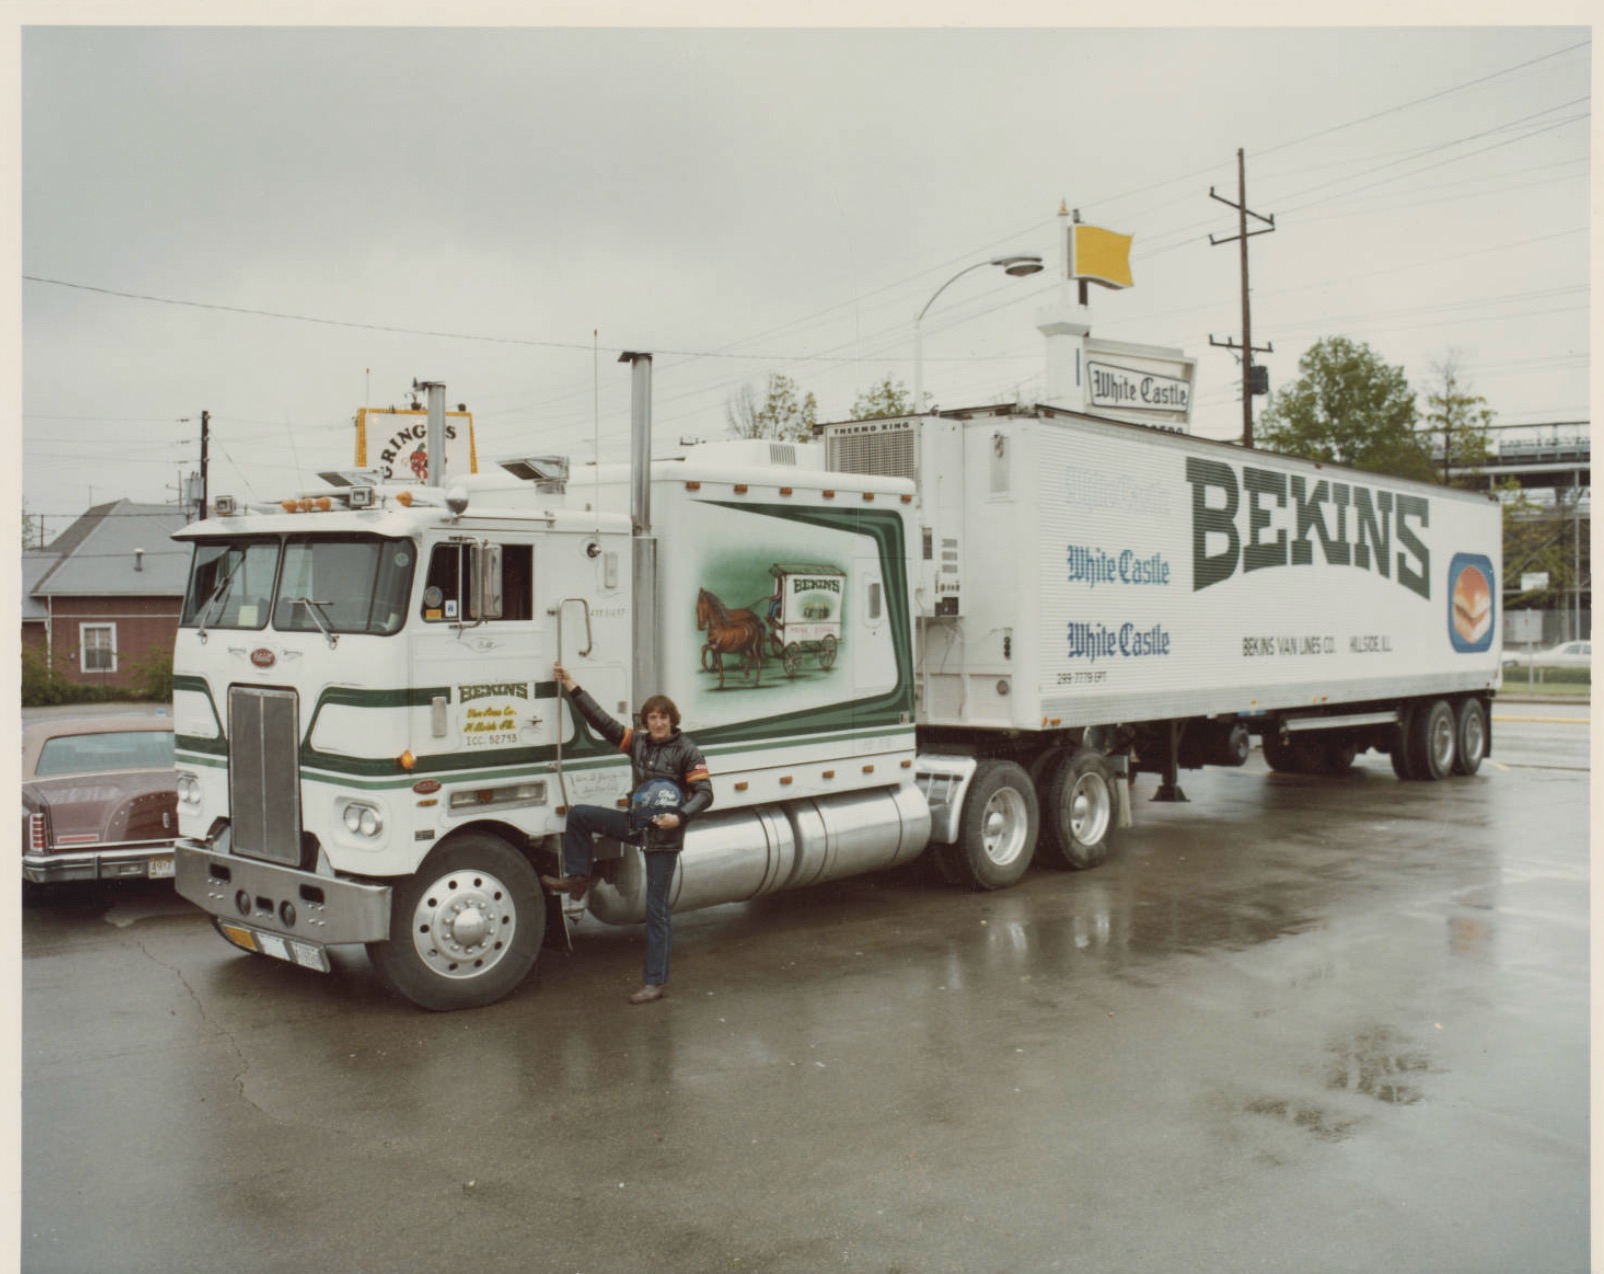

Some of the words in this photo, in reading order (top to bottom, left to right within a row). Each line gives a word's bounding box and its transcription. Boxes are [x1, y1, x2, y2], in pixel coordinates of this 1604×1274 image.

[1093, 369, 1137, 403] White
[1140, 376, 1187, 406] Castle
[834, 425, 877, 435] THERMO
[881, 422, 910, 431] KING
[381, 424, 457, 480] GRINGS
[1186, 456, 1431, 601] BEKINS
[1066, 545, 1116, 588] White
[1118, 549, 1170, 585] Castle
[793, 578, 840, 595] BEKINS
[1066, 622, 1116, 664] White
[1118, 622, 1170, 657] Castle
[1242, 636, 1274, 656] BEKINS
[1276, 636, 1298, 655] VAN
[1300, 636, 1321, 655] LINES
[458, 682, 528, 704] BEKINS
